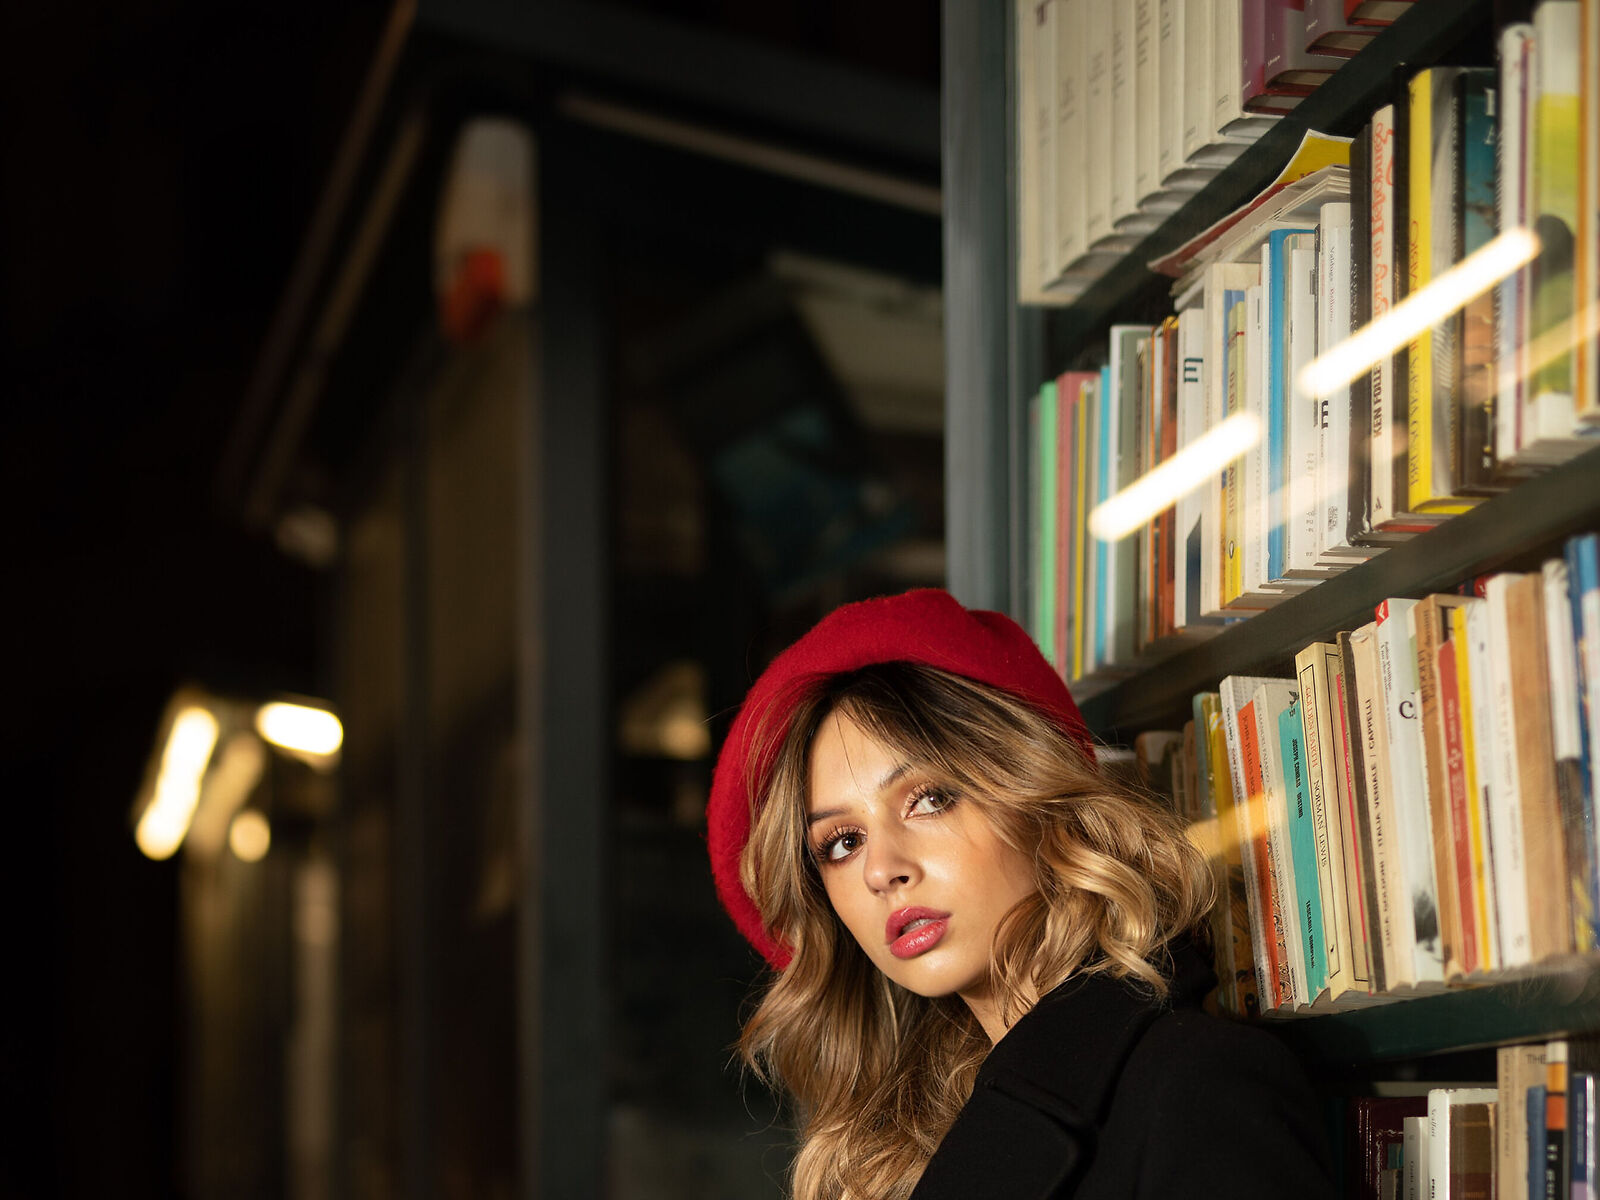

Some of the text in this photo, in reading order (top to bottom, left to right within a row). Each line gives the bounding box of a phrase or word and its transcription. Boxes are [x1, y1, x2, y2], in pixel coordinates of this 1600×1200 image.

[1371, 359, 1382, 437] KEN FOLLE
[1365, 697, 1375, 750] CAPPELLI
[1294, 761, 1302, 789] CONRAD
[1305, 686, 1328, 868] GOLDEN EARTH NORMAN LEWIS
[1370, 763, 1380, 810] VENIALE
[1375, 814, 1384, 848] ITALIA
[1525, 1053, 1547, 1065] THE
